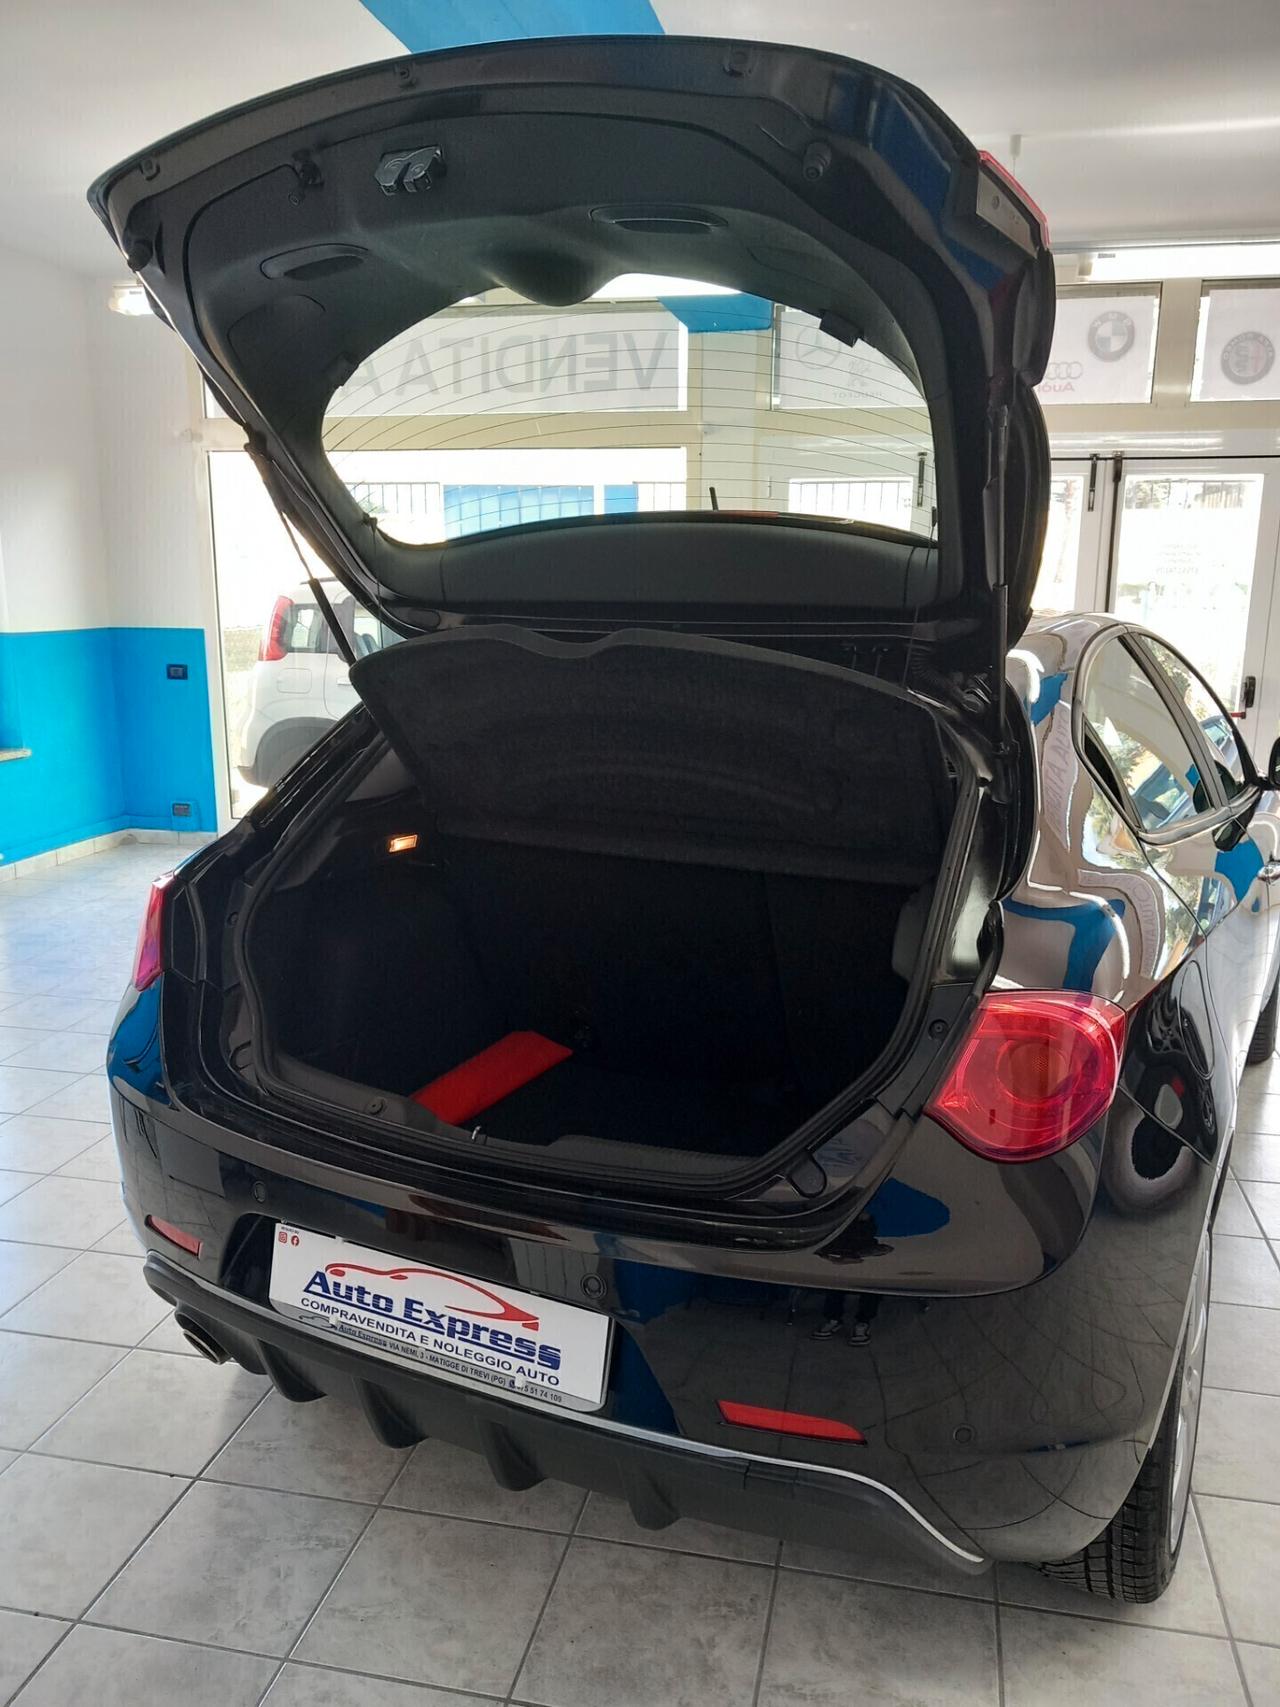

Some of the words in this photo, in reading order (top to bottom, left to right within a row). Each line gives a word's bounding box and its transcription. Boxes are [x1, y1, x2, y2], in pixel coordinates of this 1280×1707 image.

[300, 1297, 417, 1341] COMPRAVENDITA
[420, 1335, 430, 1345] E
[433, 1338, 512, 1371] NOLEGGIO
[516, 1366, 560, 1386] AUTO
[303, 1271, 394, 1313] Auto
[403, 1297, 561, 1370] Express
[389, 1341, 401, 1351] VIA
[429, 1353, 460, 1370] MATIGGE
[461, 1364, 469, 1373] DI
[470, 1366, 490, 1380] TREVI
